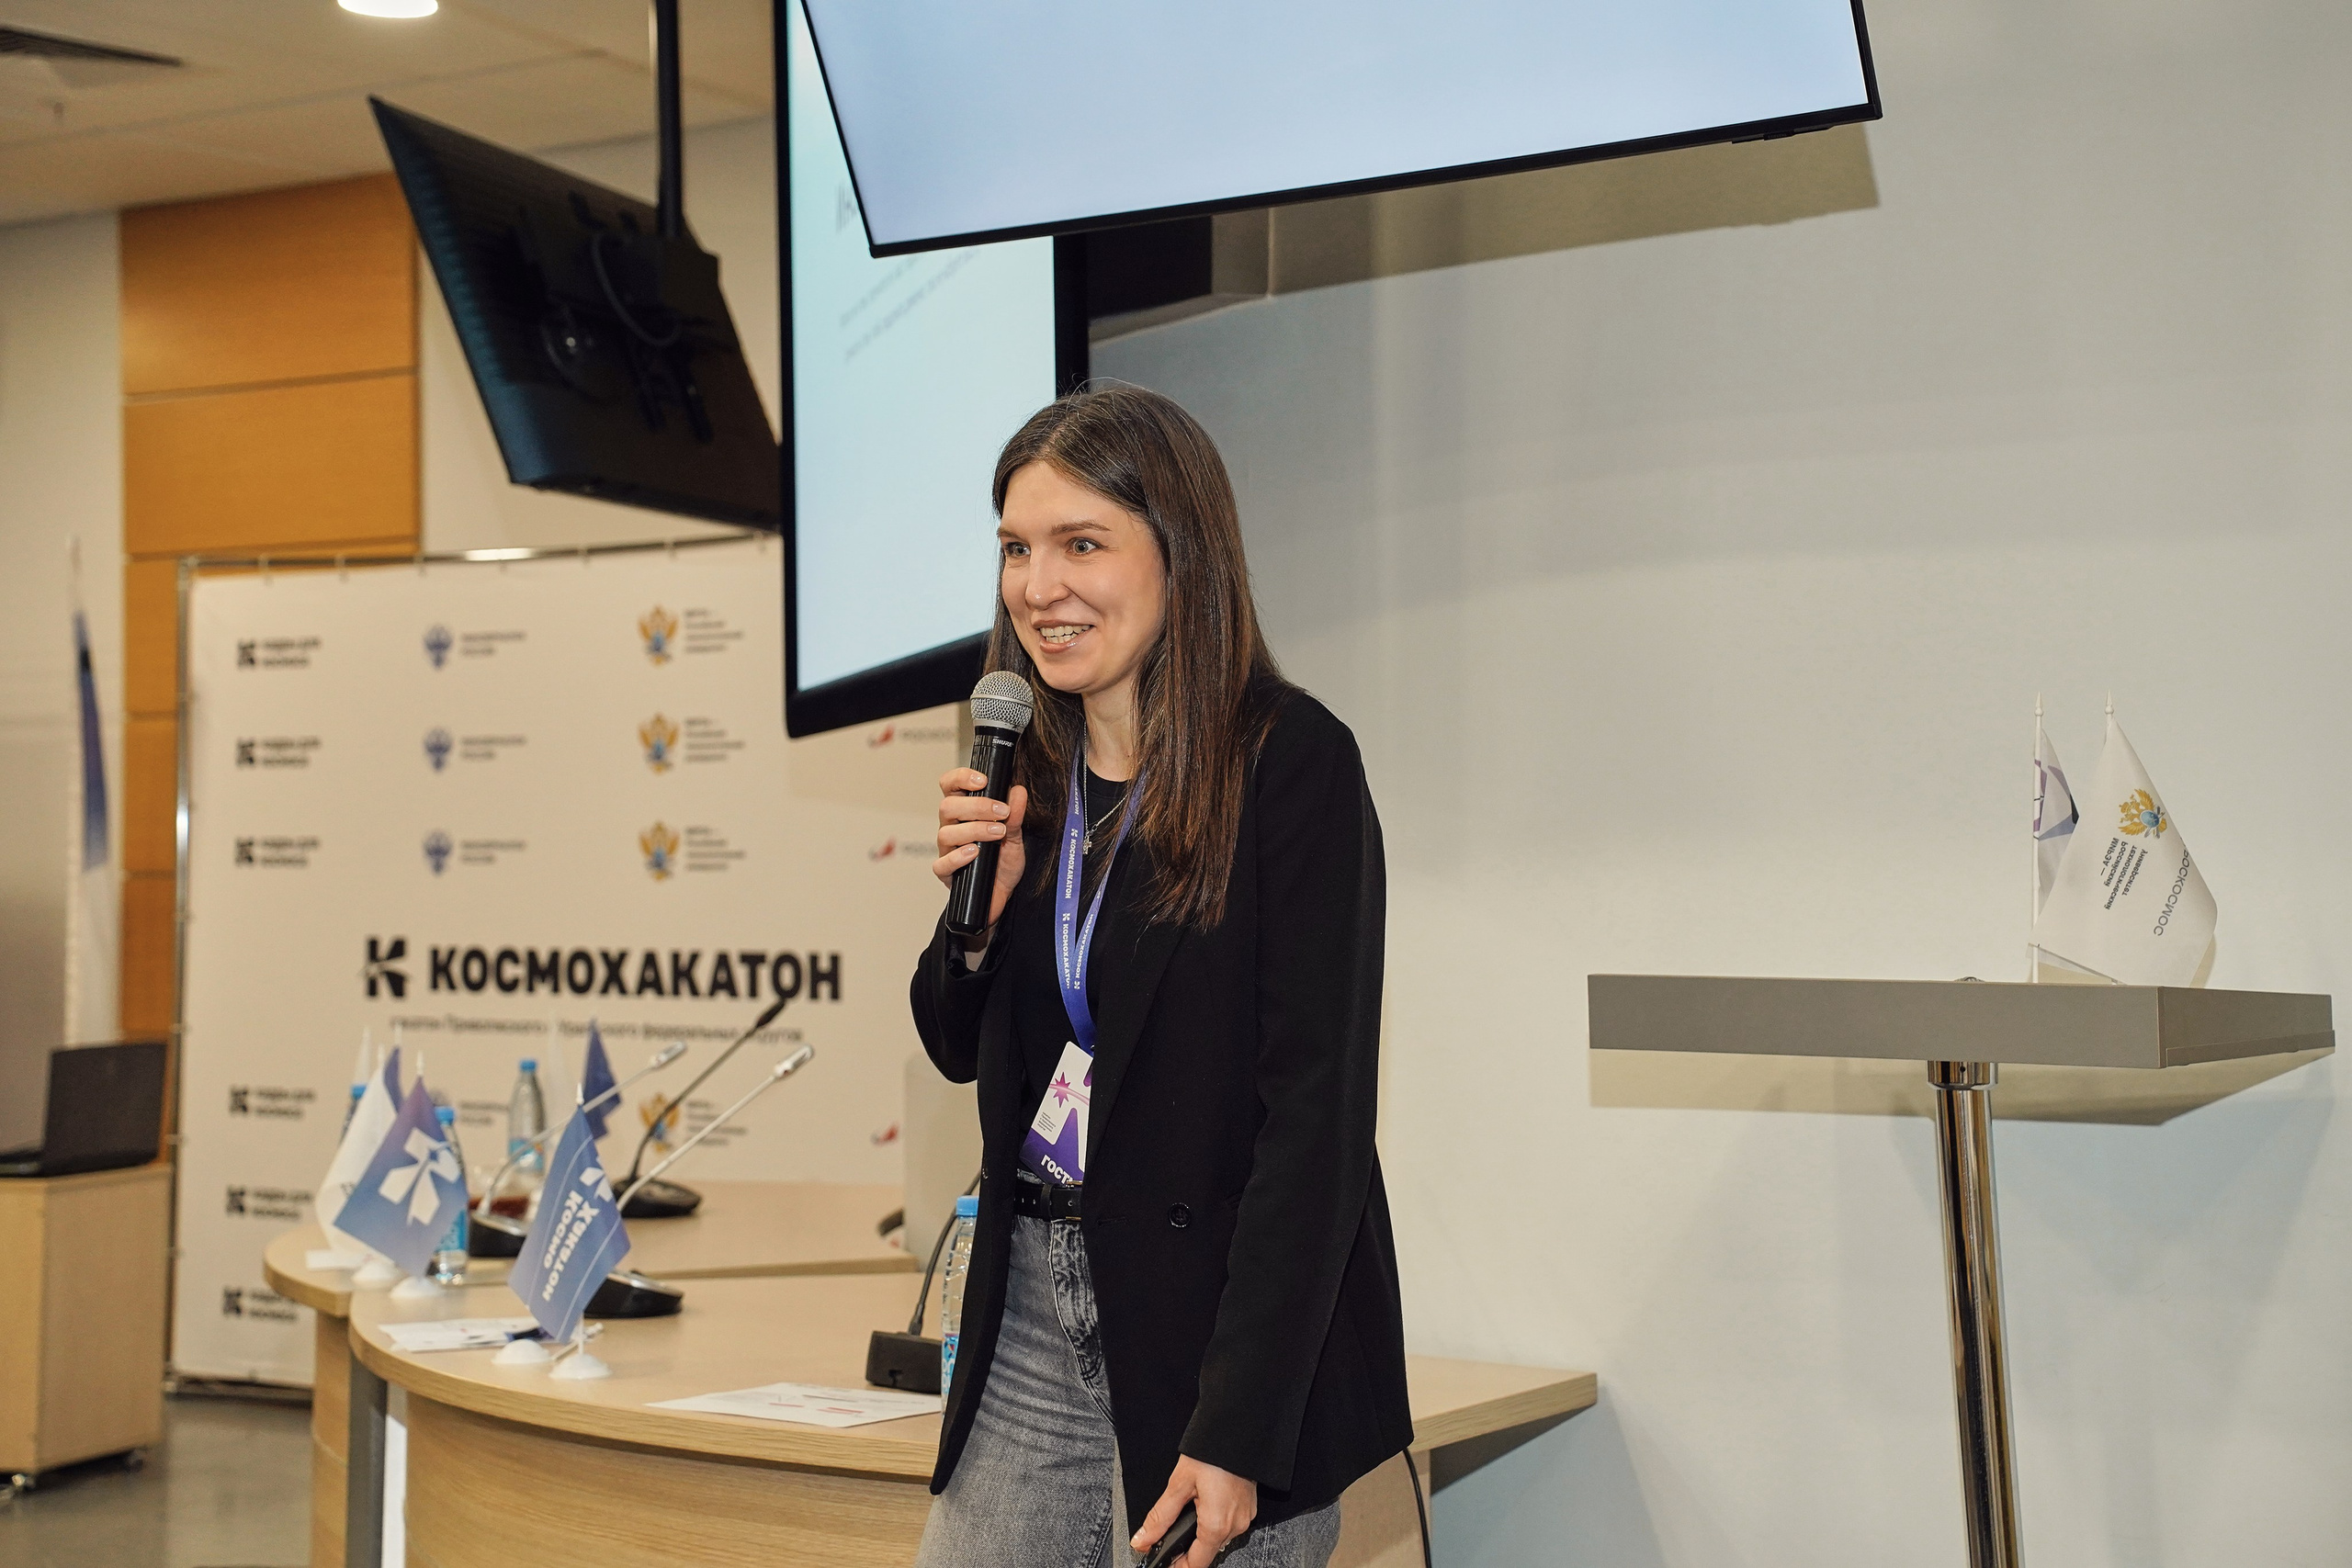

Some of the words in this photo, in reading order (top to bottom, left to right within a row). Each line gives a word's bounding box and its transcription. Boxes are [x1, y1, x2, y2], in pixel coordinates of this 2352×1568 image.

[1065, 839, 1077, 898] КОСМОХАКАТОН
[429, 947, 842, 1000] КОСМОХАКАТОН
[1062, 923, 1070, 989] КОСМОХАКАТО
[1075, 914, 1094, 978] КОСМОХАКАТОН
